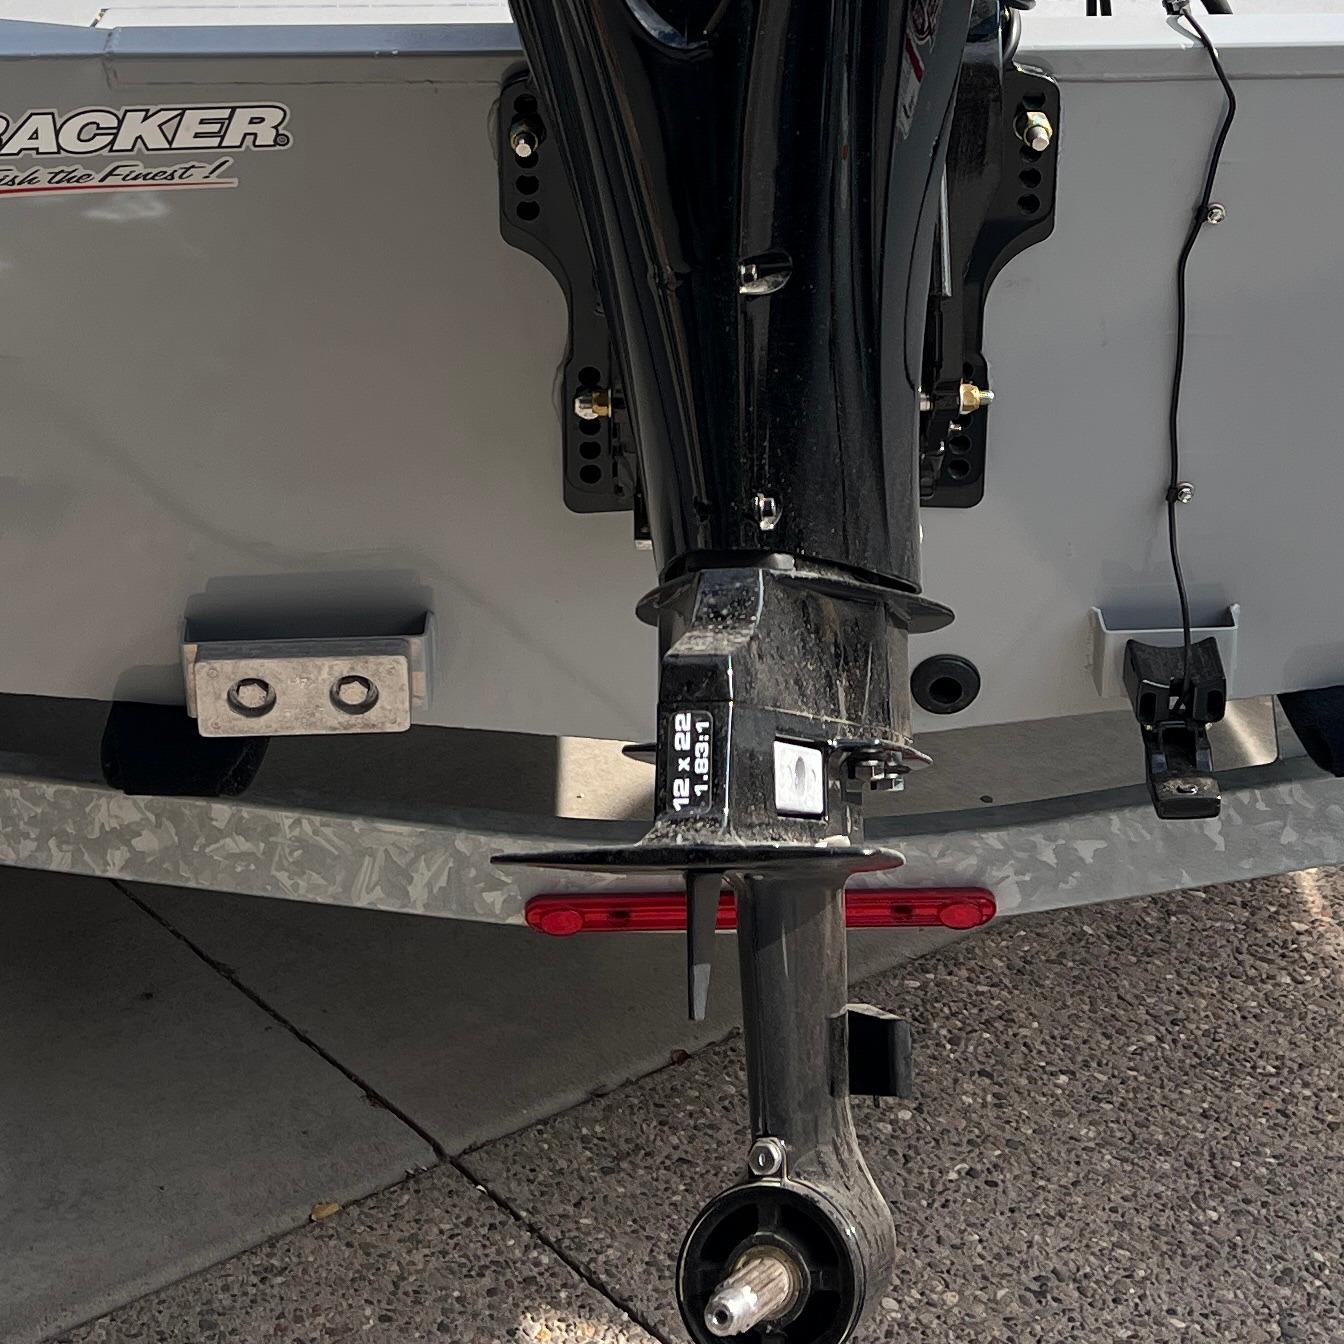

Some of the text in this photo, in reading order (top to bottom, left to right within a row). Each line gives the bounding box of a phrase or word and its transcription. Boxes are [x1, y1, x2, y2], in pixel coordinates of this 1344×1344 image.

[44, 166, 93, 185] the
[673, 712, 692, 812] 12 x 22
[694, 720, 710, 797] 1.83:1
